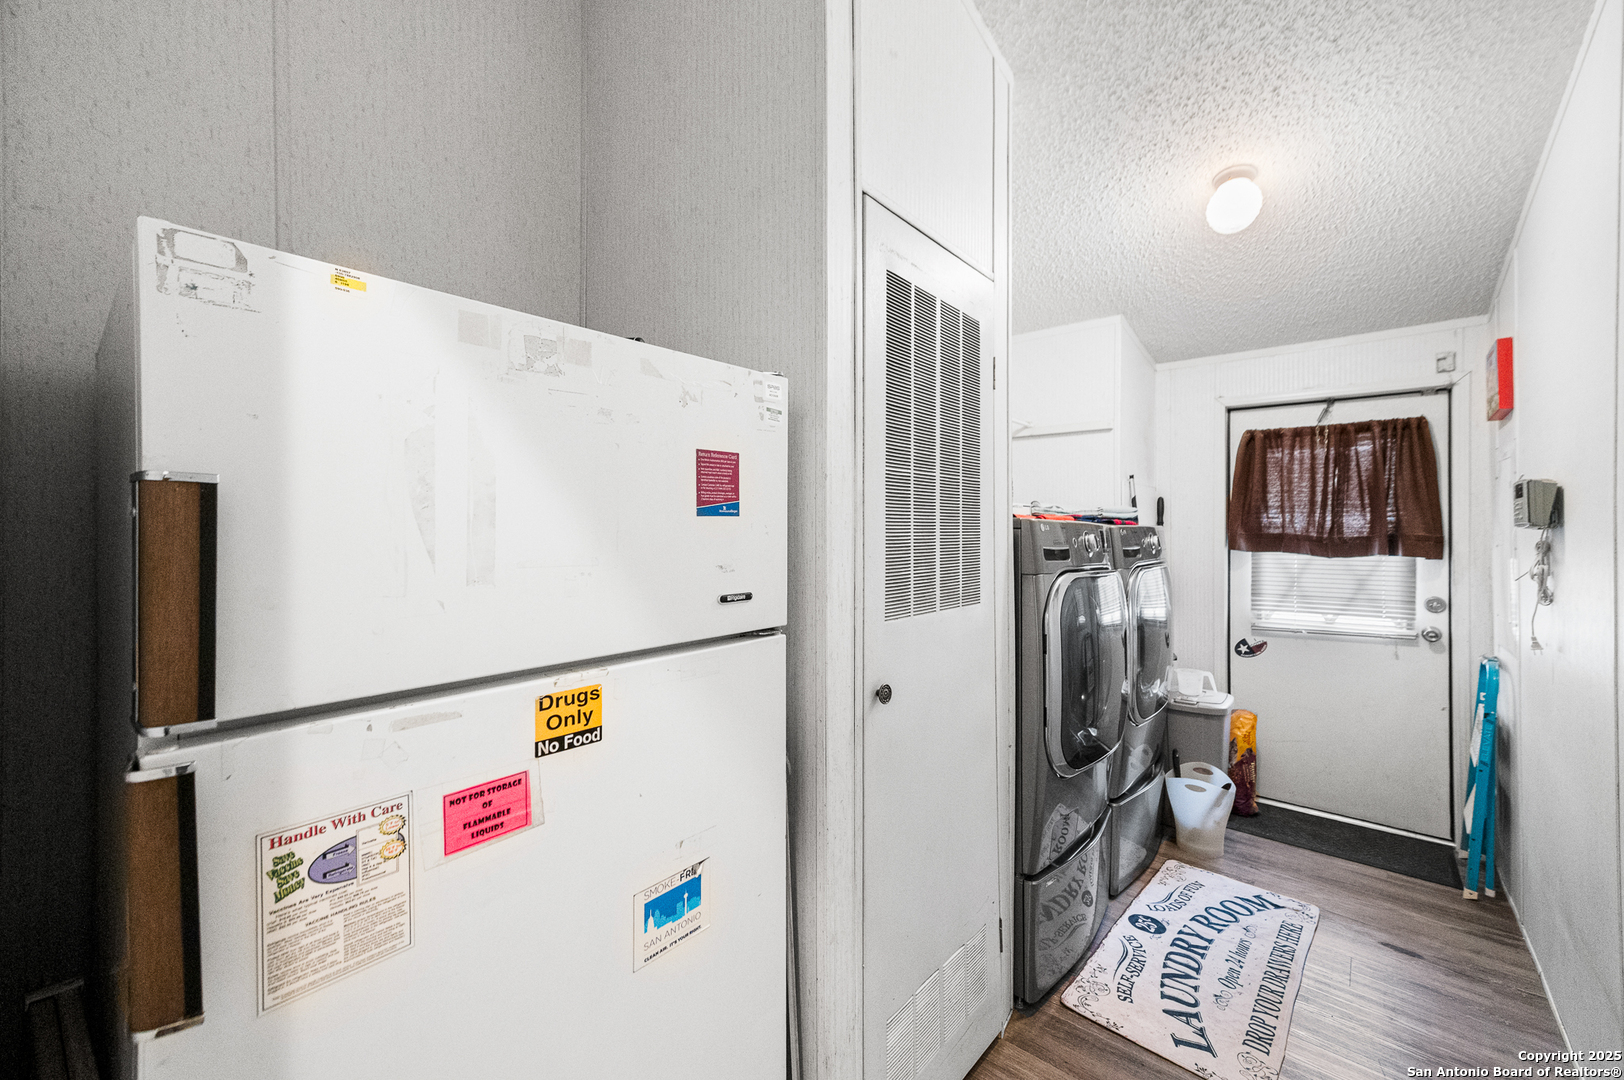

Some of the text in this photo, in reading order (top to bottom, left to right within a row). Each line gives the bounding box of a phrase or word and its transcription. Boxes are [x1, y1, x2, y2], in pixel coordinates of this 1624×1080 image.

[539, 688, 600, 712] Drugs
[546, 709, 594, 730] Only
[538, 726, 600, 756] No Food
[450, 778, 522, 807] NOT FOR STORAGE
[482, 800, 493, 809] OF
[268, 824, 327, 850] Handle
[330, 812, 366, 830] With
[370, 802, 404, 818] Care
[463, 808, 511, 830] FLAMMABLE
[471, 822, 504, 839] LIQUIDS
[266, 857, 304, 881] Vaccine
[272, 851, 296, 868] Save
[273, 877, 305, 904] Money
[276, 870, 300, 889] Save
[644, 865, 697, 901] SMOKE-FR
[1146, 880, 1206, 912] LOADS OF FUN
[644, 911, 702, 952] SAN ANTONIO
[644, 950, 659, 963] CLEAN
[678, 932, 689, 942] YOUR
[1116, 935, 1147, 1004] SELF-SERVICE
[1160, 894, 1286, 1058] LAUNDRY ROOM
[1218, 938, 1252, 990] Open 24 hours
[1242, 920, 1304, 1056] DROP YOUR DRAWERS HERE
